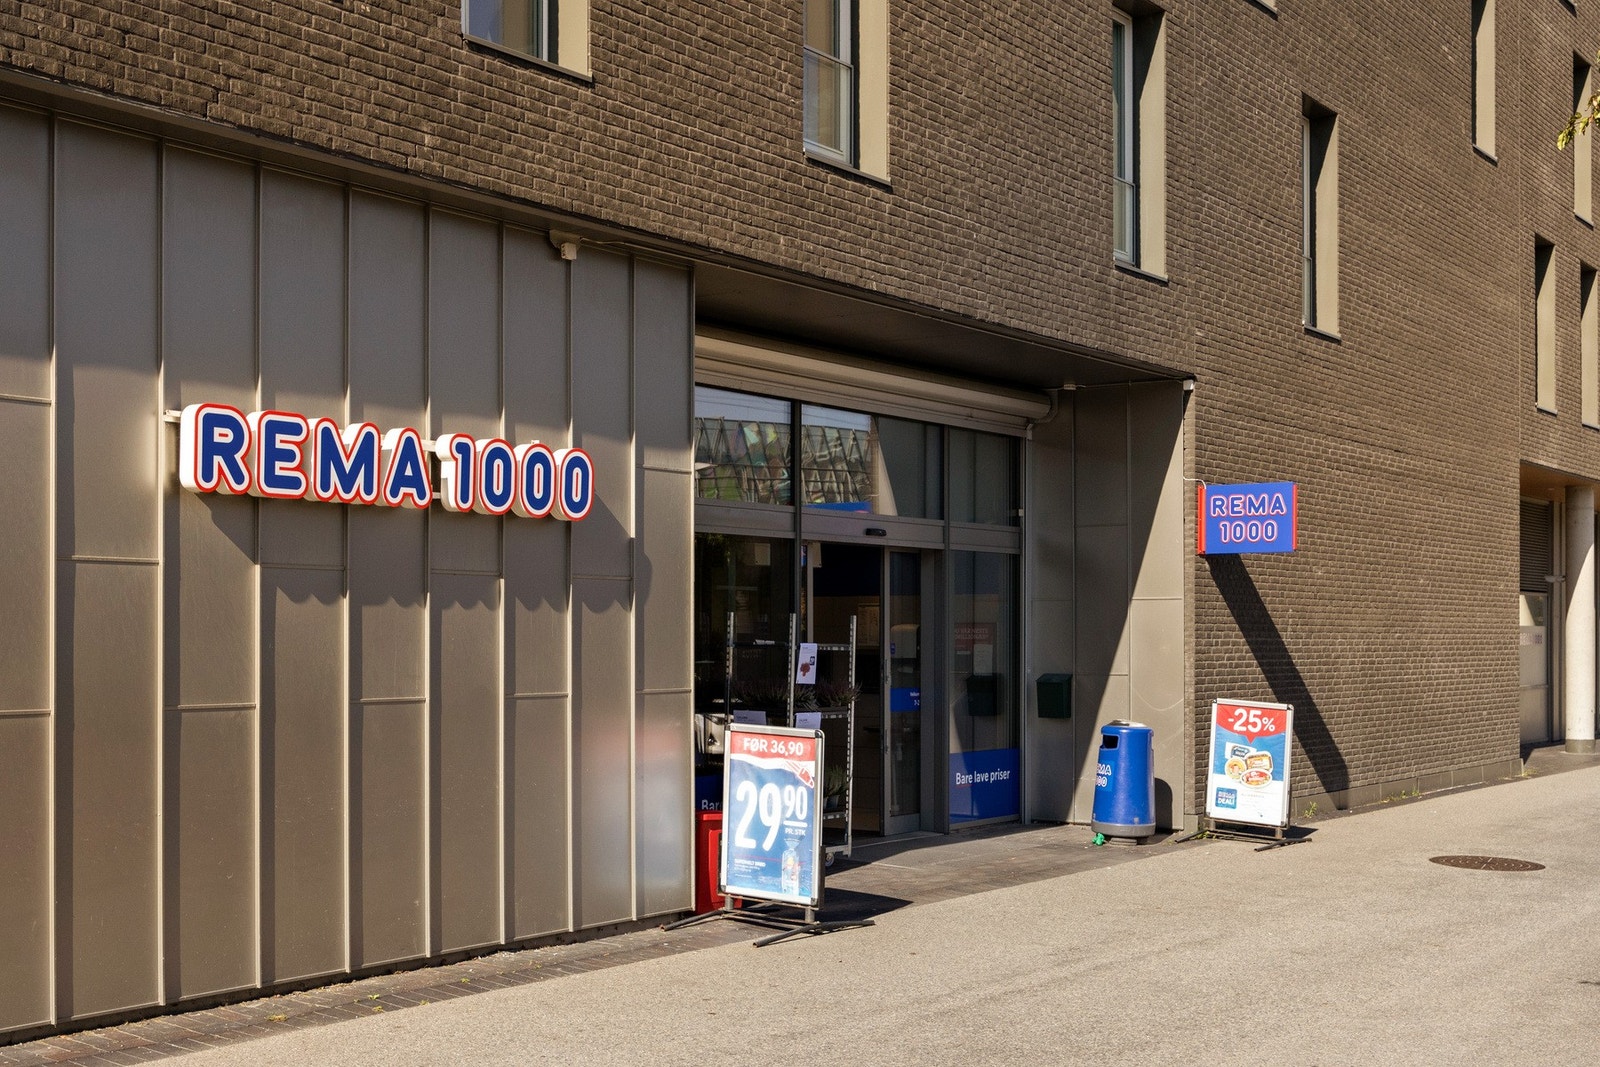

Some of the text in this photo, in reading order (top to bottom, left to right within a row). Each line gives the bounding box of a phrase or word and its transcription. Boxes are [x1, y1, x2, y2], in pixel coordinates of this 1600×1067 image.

[193, 402, 595, 522] REMA 1000
[1210, 492, 1287, 517] REMA
[1219, 520, 1278, 544] 1000
[1227, 708, 1276, 733] -25%
[743, 737, 804, 756] FØR 36,90
[955, 768, 1011, 785] Bare lave priser
[701, 799, 722, 811] Bar
[734, 780, 808, 852] 29 90
